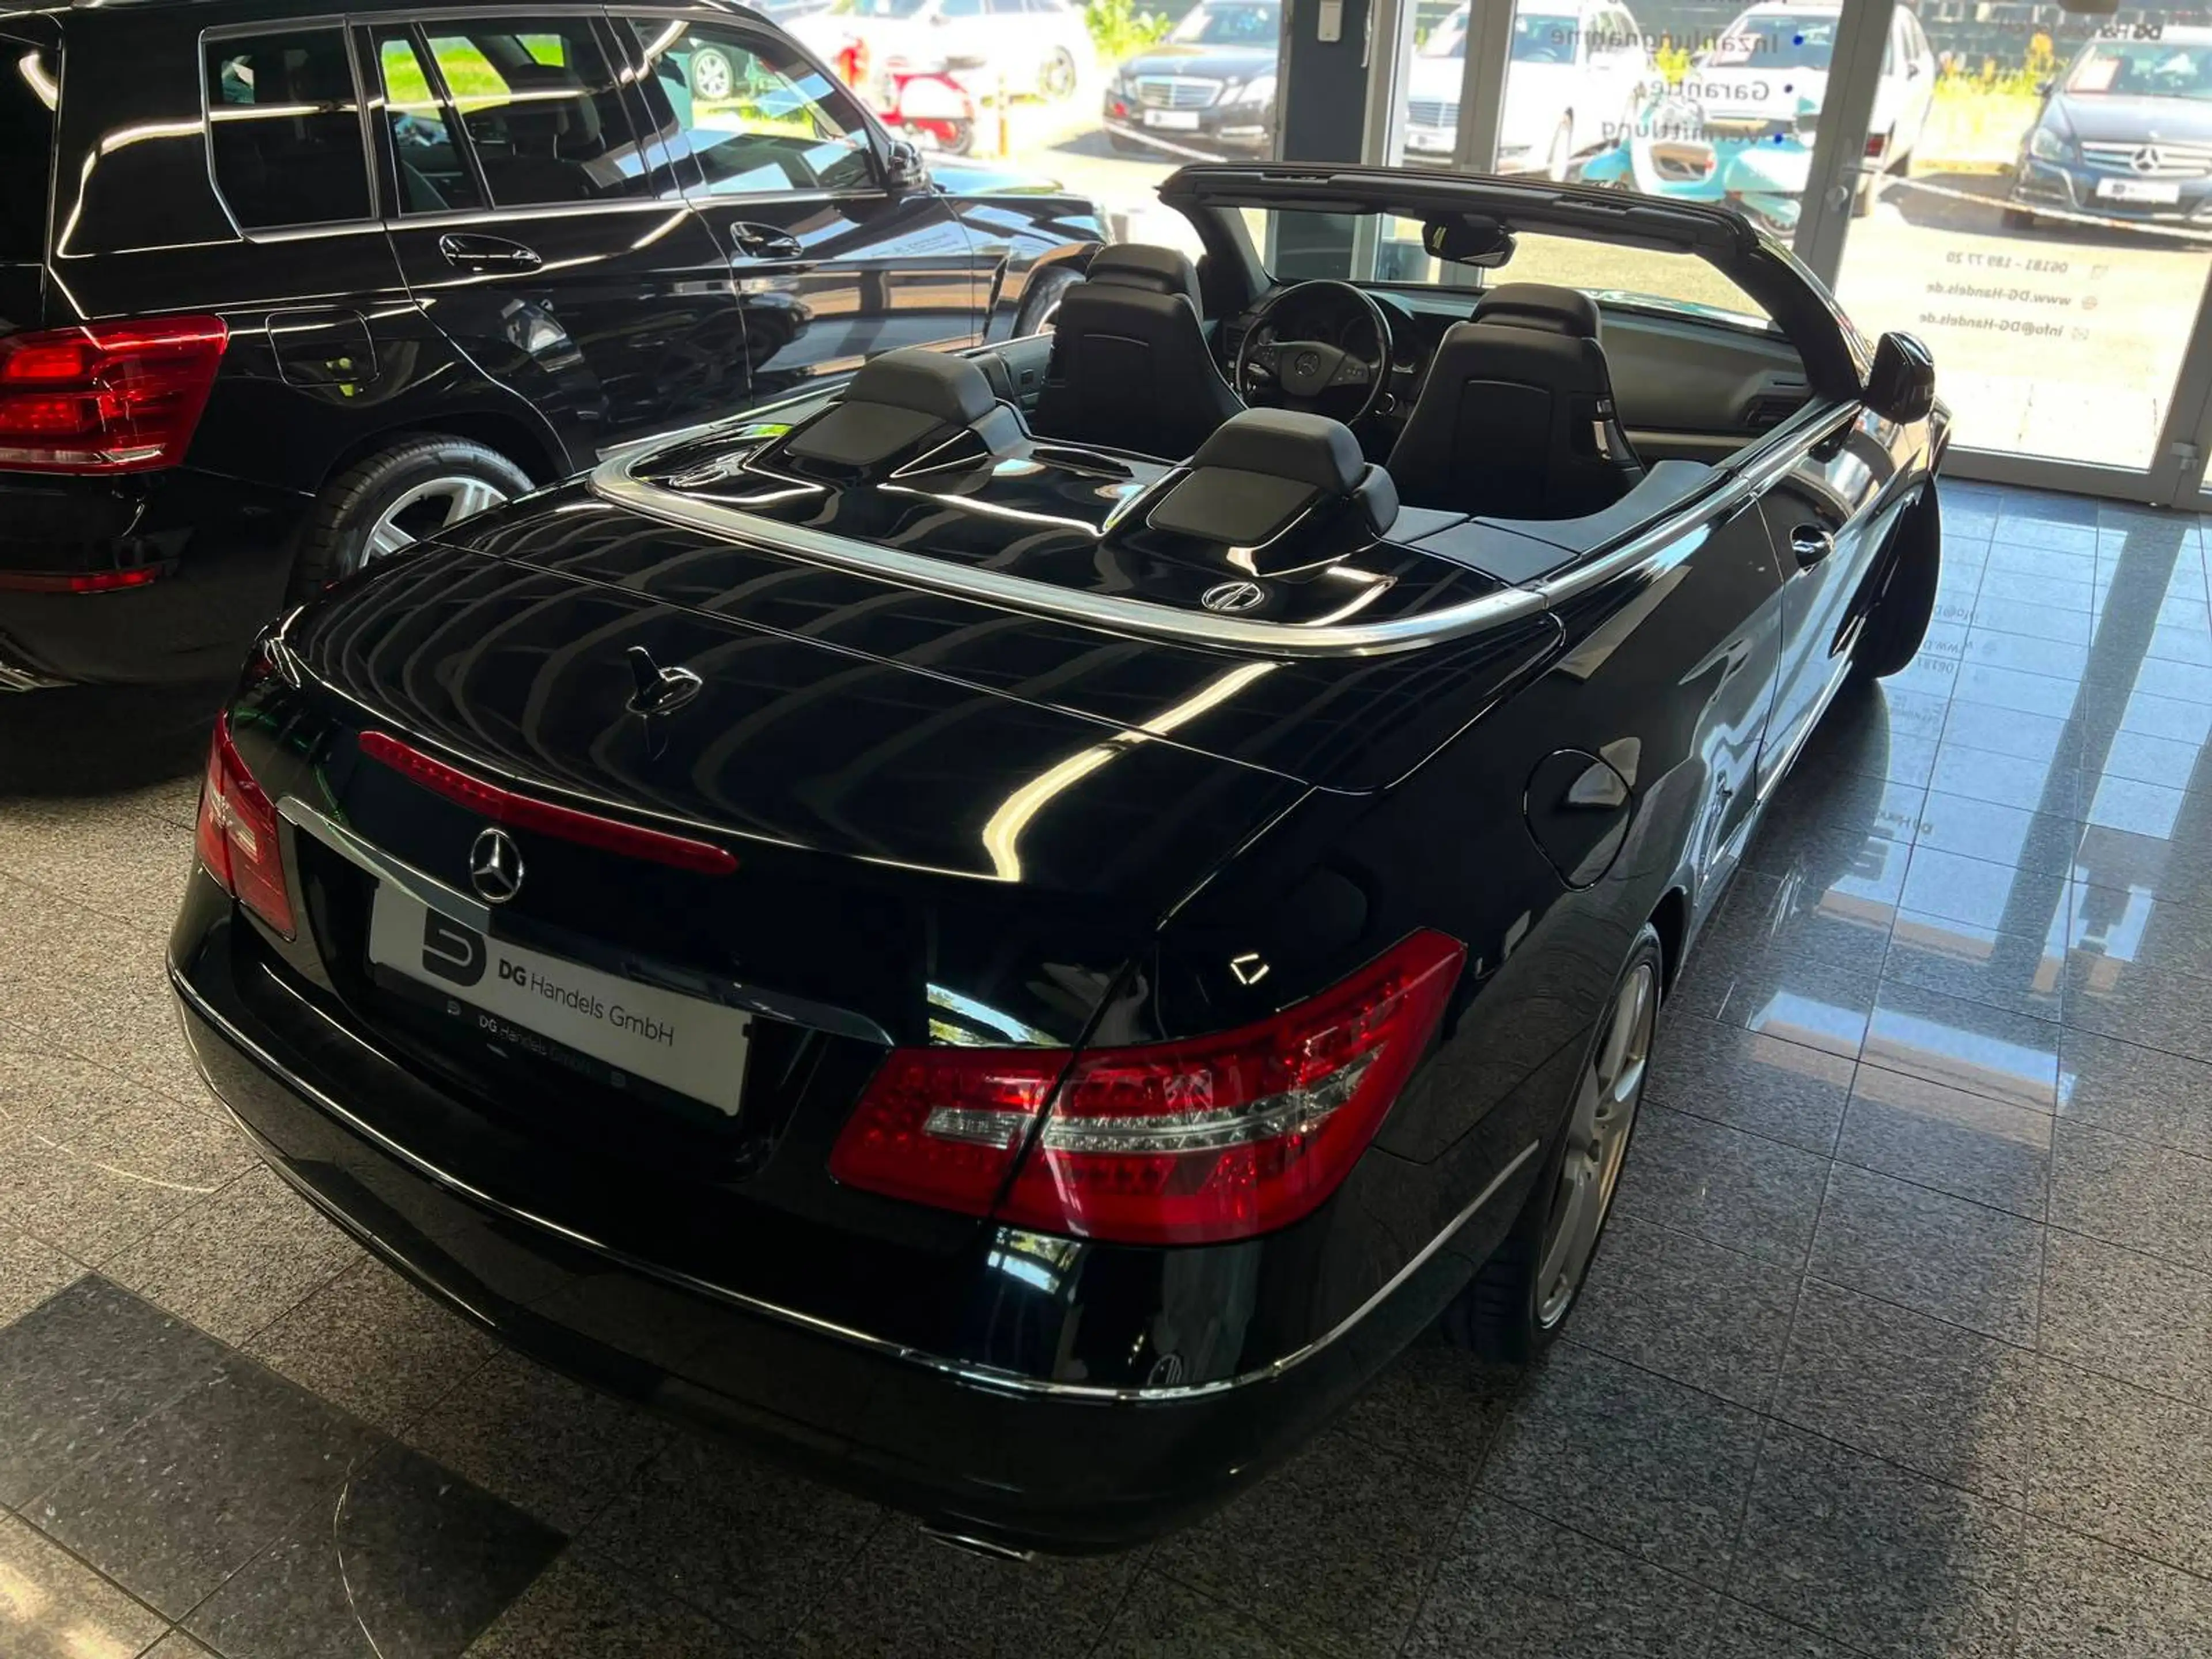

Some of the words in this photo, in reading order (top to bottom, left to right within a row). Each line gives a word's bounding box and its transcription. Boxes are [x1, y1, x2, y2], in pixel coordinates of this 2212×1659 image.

[479, 1014, 498, 1033] DG
[498, 958, 526, 987] DG
[531, 973, 604, 1019] Handels
[609, 1005, 675, 1047] GmbH
